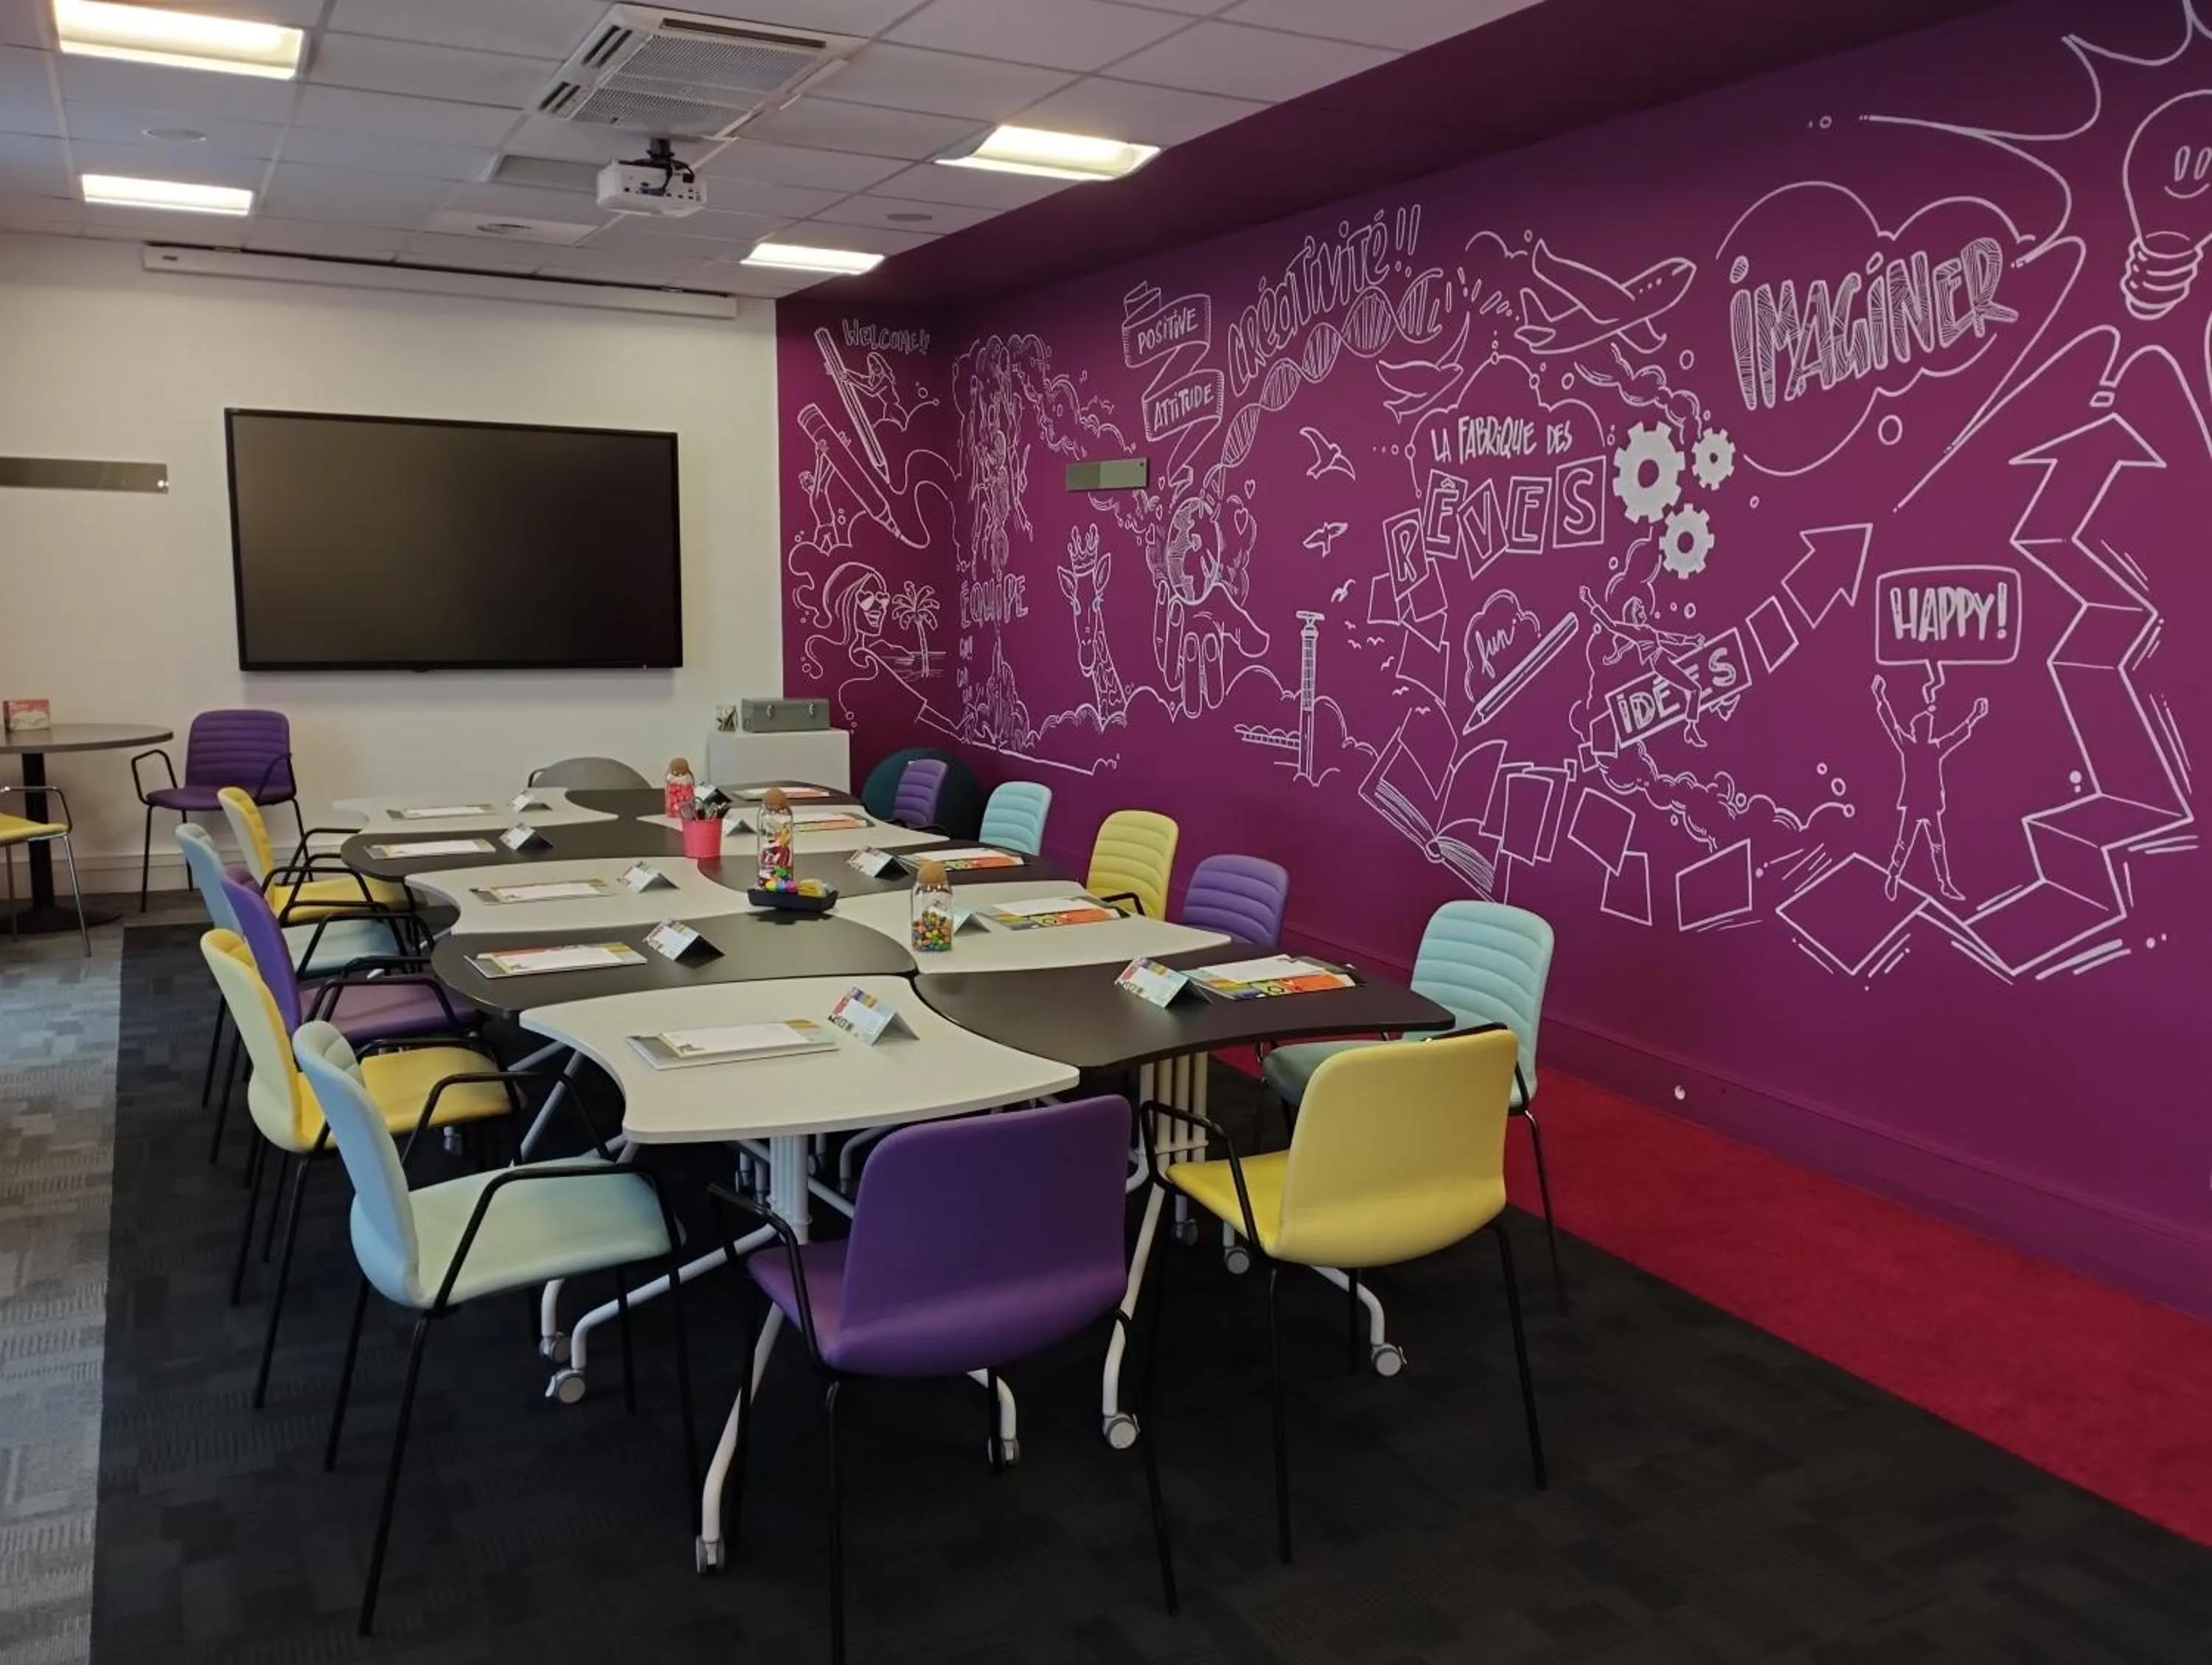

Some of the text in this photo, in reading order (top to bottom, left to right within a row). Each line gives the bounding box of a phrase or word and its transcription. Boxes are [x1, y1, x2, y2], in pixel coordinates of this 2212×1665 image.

[1430, 428, 1452, 463] LA
[1546, 420, 1573, 456] DES
[1889, 582, 2008, 642] HAPPY!
